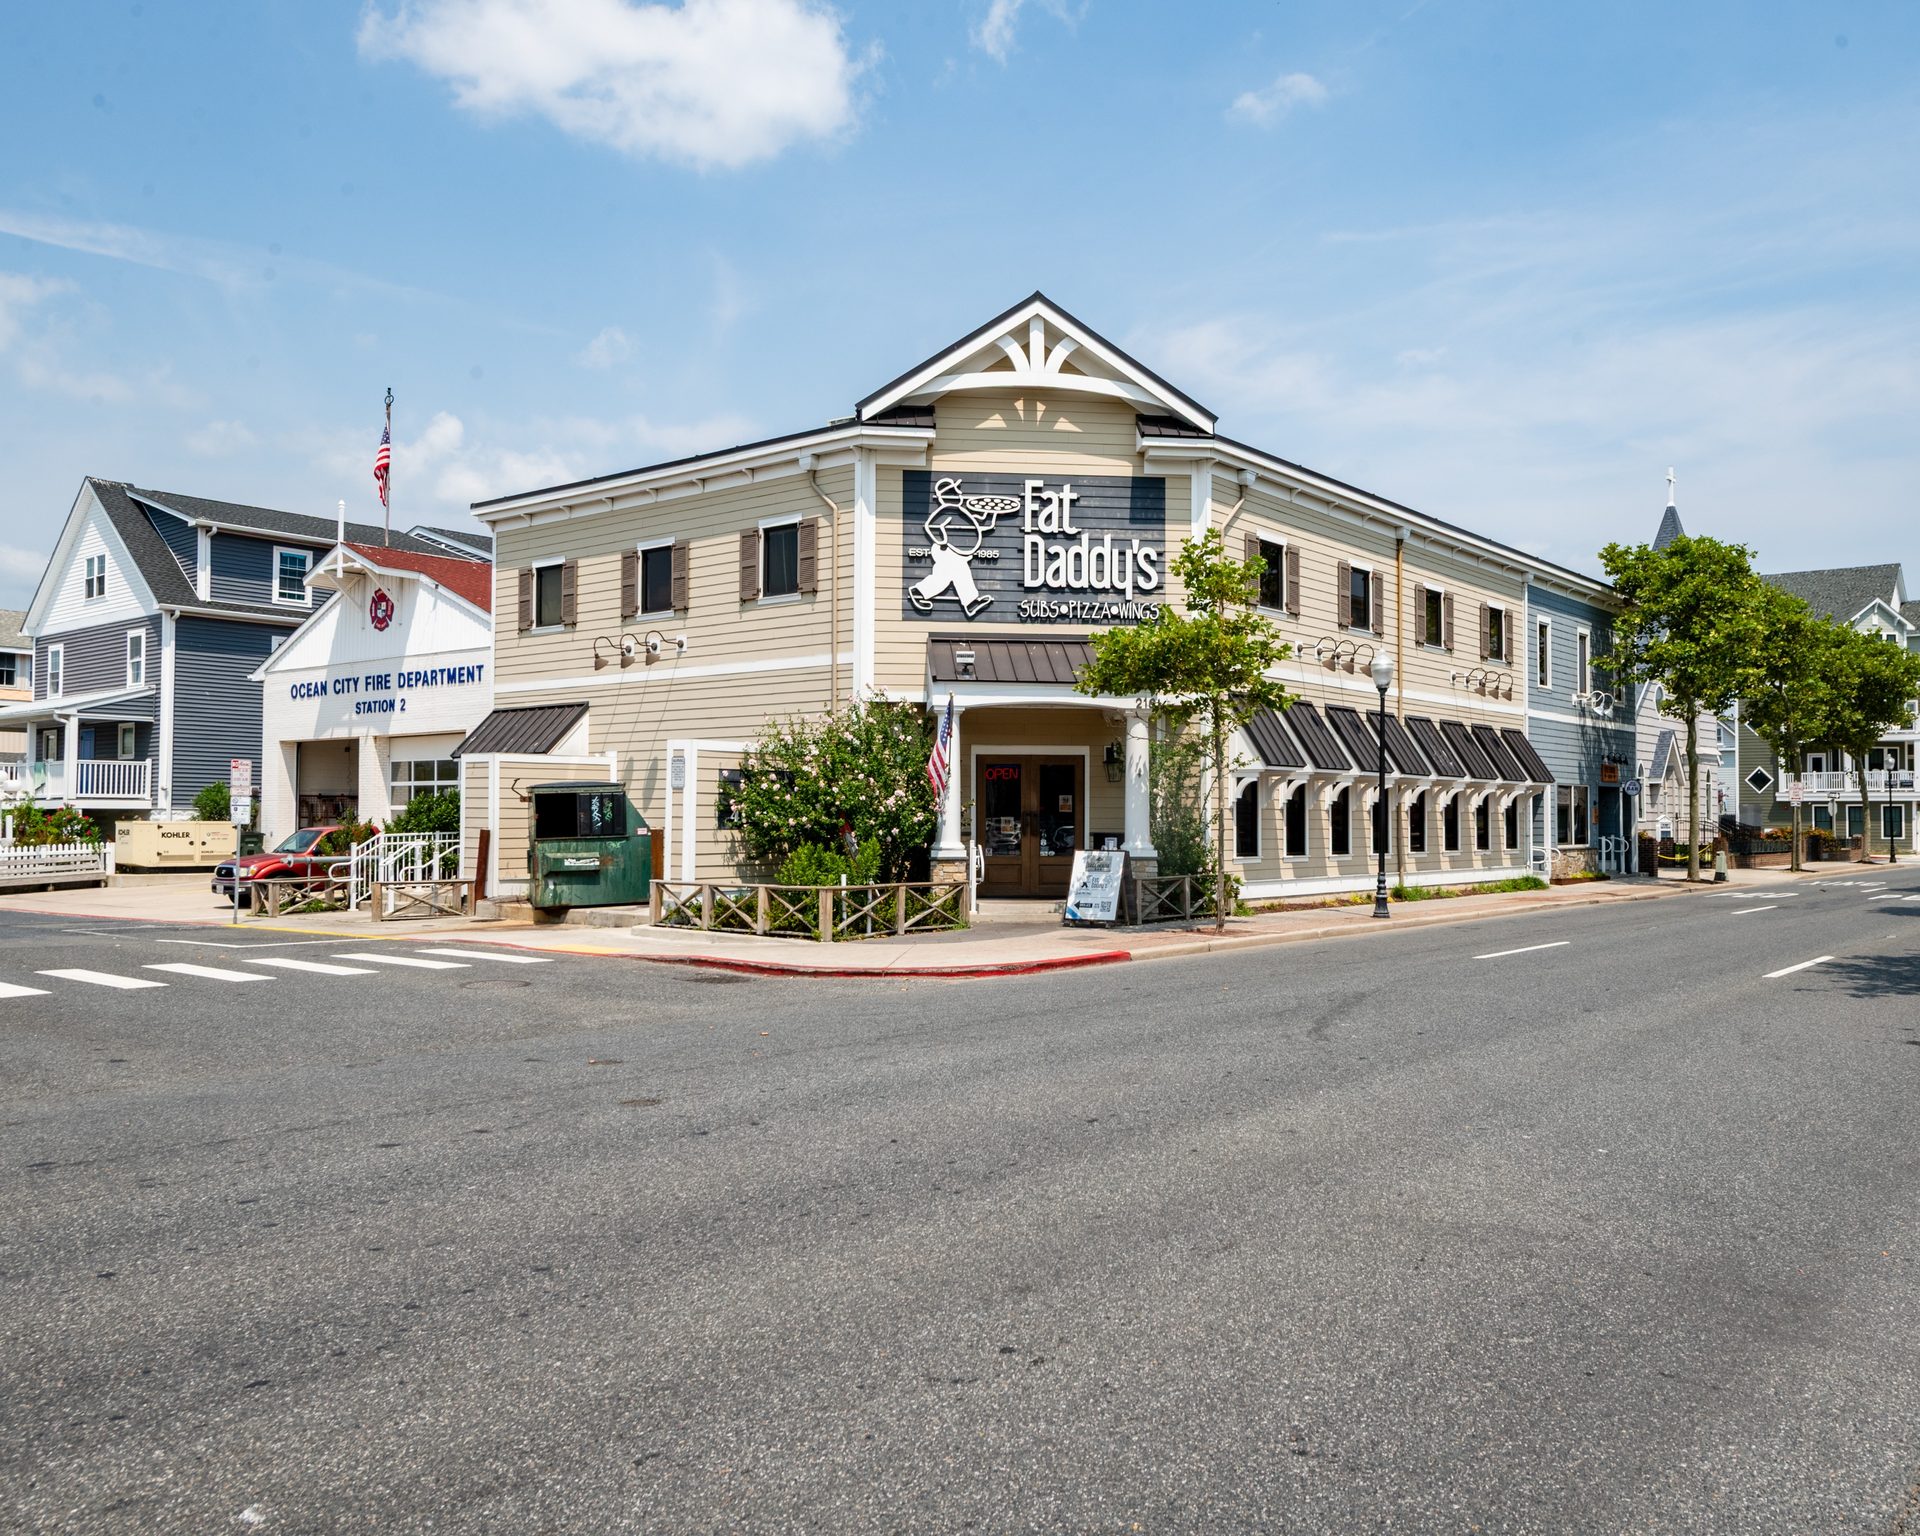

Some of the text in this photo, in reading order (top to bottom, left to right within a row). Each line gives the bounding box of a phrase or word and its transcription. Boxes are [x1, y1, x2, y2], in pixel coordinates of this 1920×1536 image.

[1024, 479, 1079, 535] Fat
[908, 547, 1000, 559] EST 1985
[1023, 532, 1159, 601] Daddy's
[290, 664, 485, 700] OCEAN CITY FIRE DEPARTMENT
[355, 698, 406, 715] STATION 2
[984, 767, 1019, 780] OPEN
[161, 831, 190, 839] KOHLER
